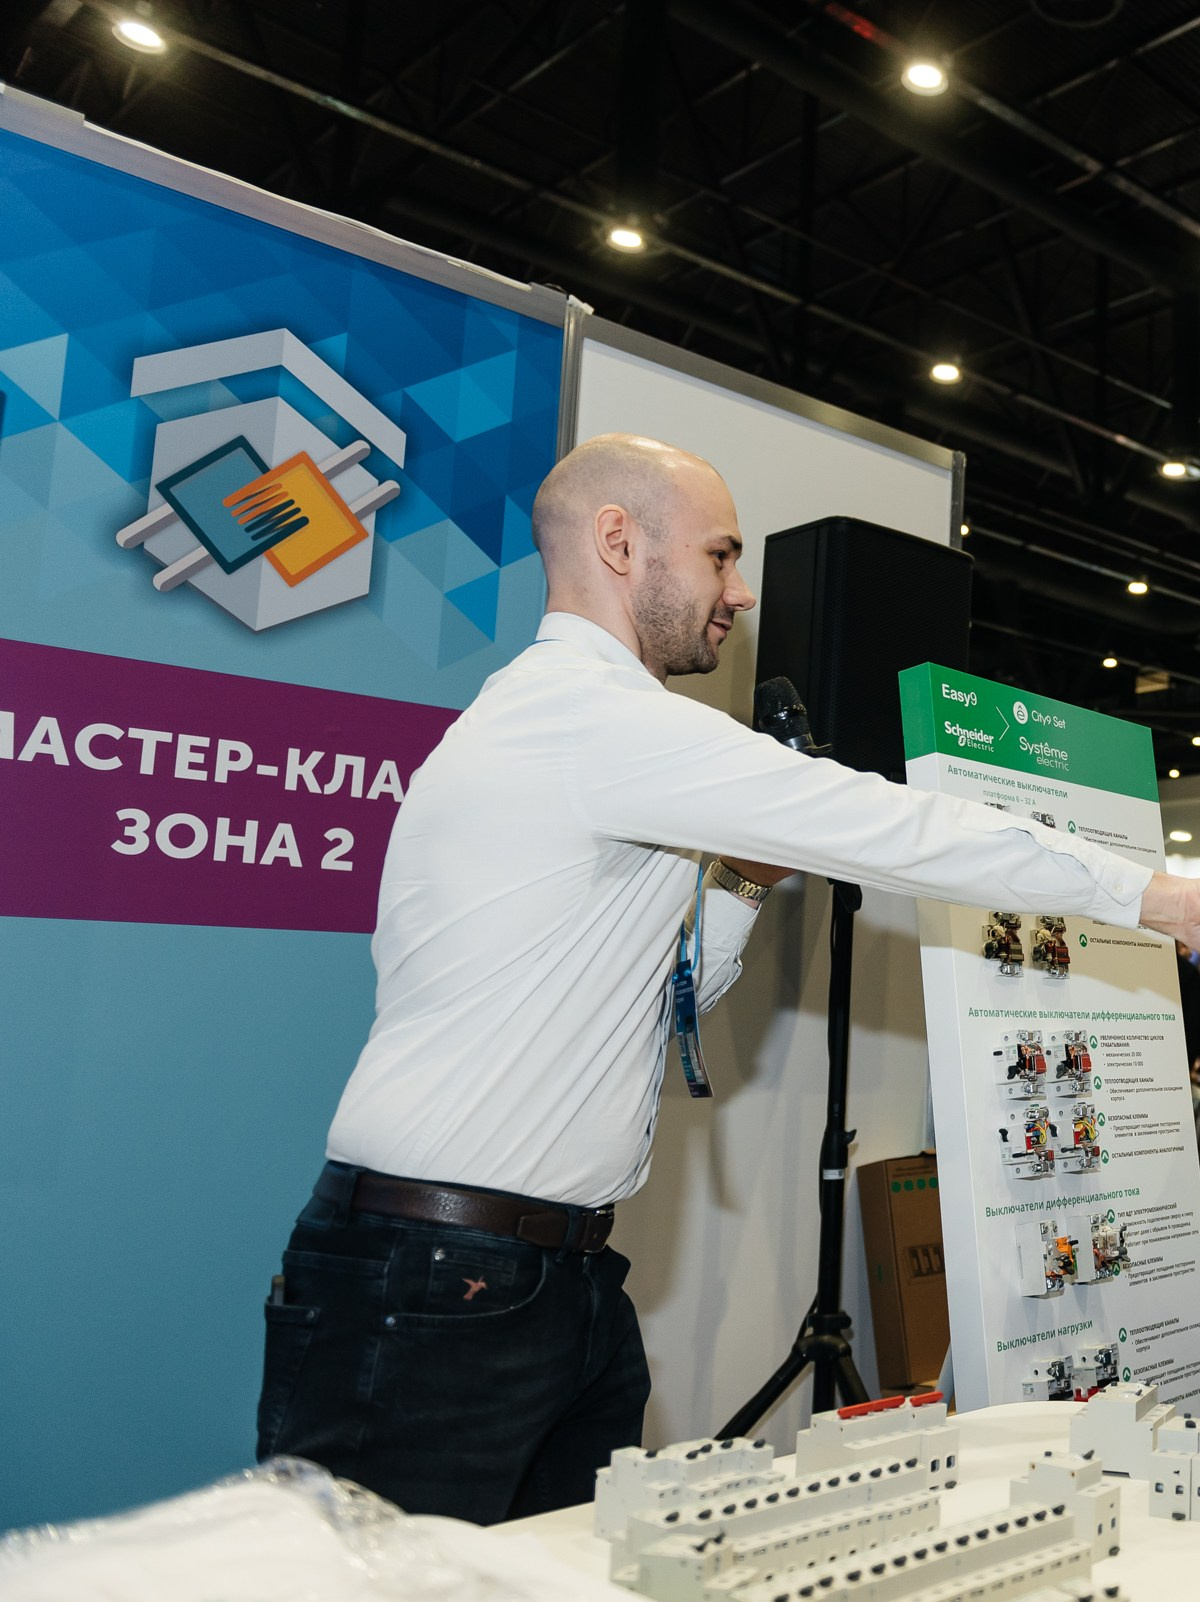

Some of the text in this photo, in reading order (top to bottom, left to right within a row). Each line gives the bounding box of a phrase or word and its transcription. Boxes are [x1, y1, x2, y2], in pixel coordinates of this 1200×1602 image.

[942, 683, 977, 707] Easy9
[1031, 710, 1051, 726] City9
[1053, 716, 1066, 729] Set
[944, 720, 994, 745] Schneider
[0, 710, 406, 803] АСТЕР-КЛА
[967, 738, 994, 753] Electric
[1019, 736, 1068, 761] Système
[1036, 756, 1070, 771] electric
[947, 764, 1068, 799] Автоматические выключатели
[983, 789, 1015, 803] платформа
[110, 808, 355, 871] ЗОНА 2
[969, 1007, 1176, 1022] Автоматические выключатели дифференциального тока
[985, 1187, 1140, 1218] Выключатели дифференциального тока
[997, 1320, 1093, 1352] Выключатели нагрузки
